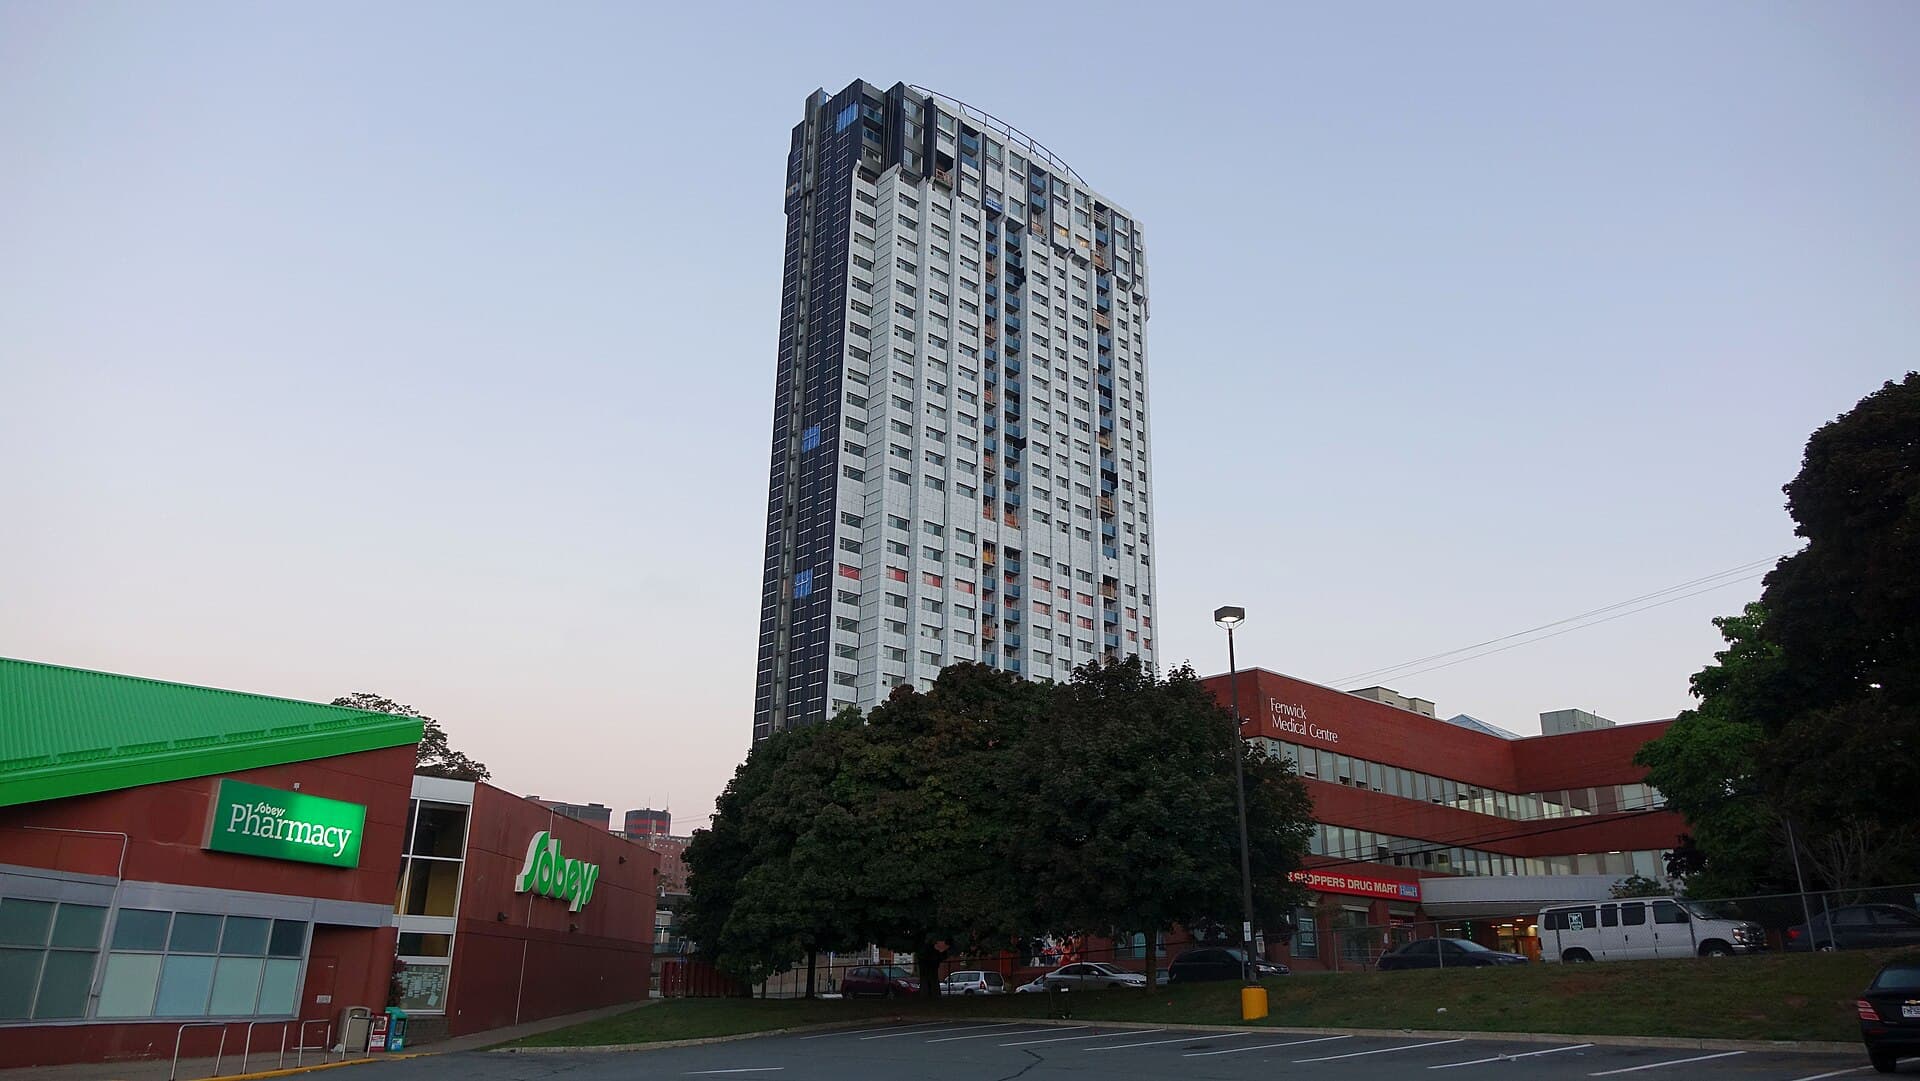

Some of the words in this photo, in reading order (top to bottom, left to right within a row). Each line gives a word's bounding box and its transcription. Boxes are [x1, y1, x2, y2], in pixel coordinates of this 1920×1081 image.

[1270, 697, 1307, 719] Fenwick
[1272, 714, 1307, 735] Medical
[1309, 723, 1338, 743] Centre
[254, 801, 286, 817] Sobeys
[227, 804, 352, 857] Pharmacy
[515, 831, 599, 912] Sobeys
[1348, 879, 1373, 891] DRUG
[1374, 882, 1398, 894] MART
